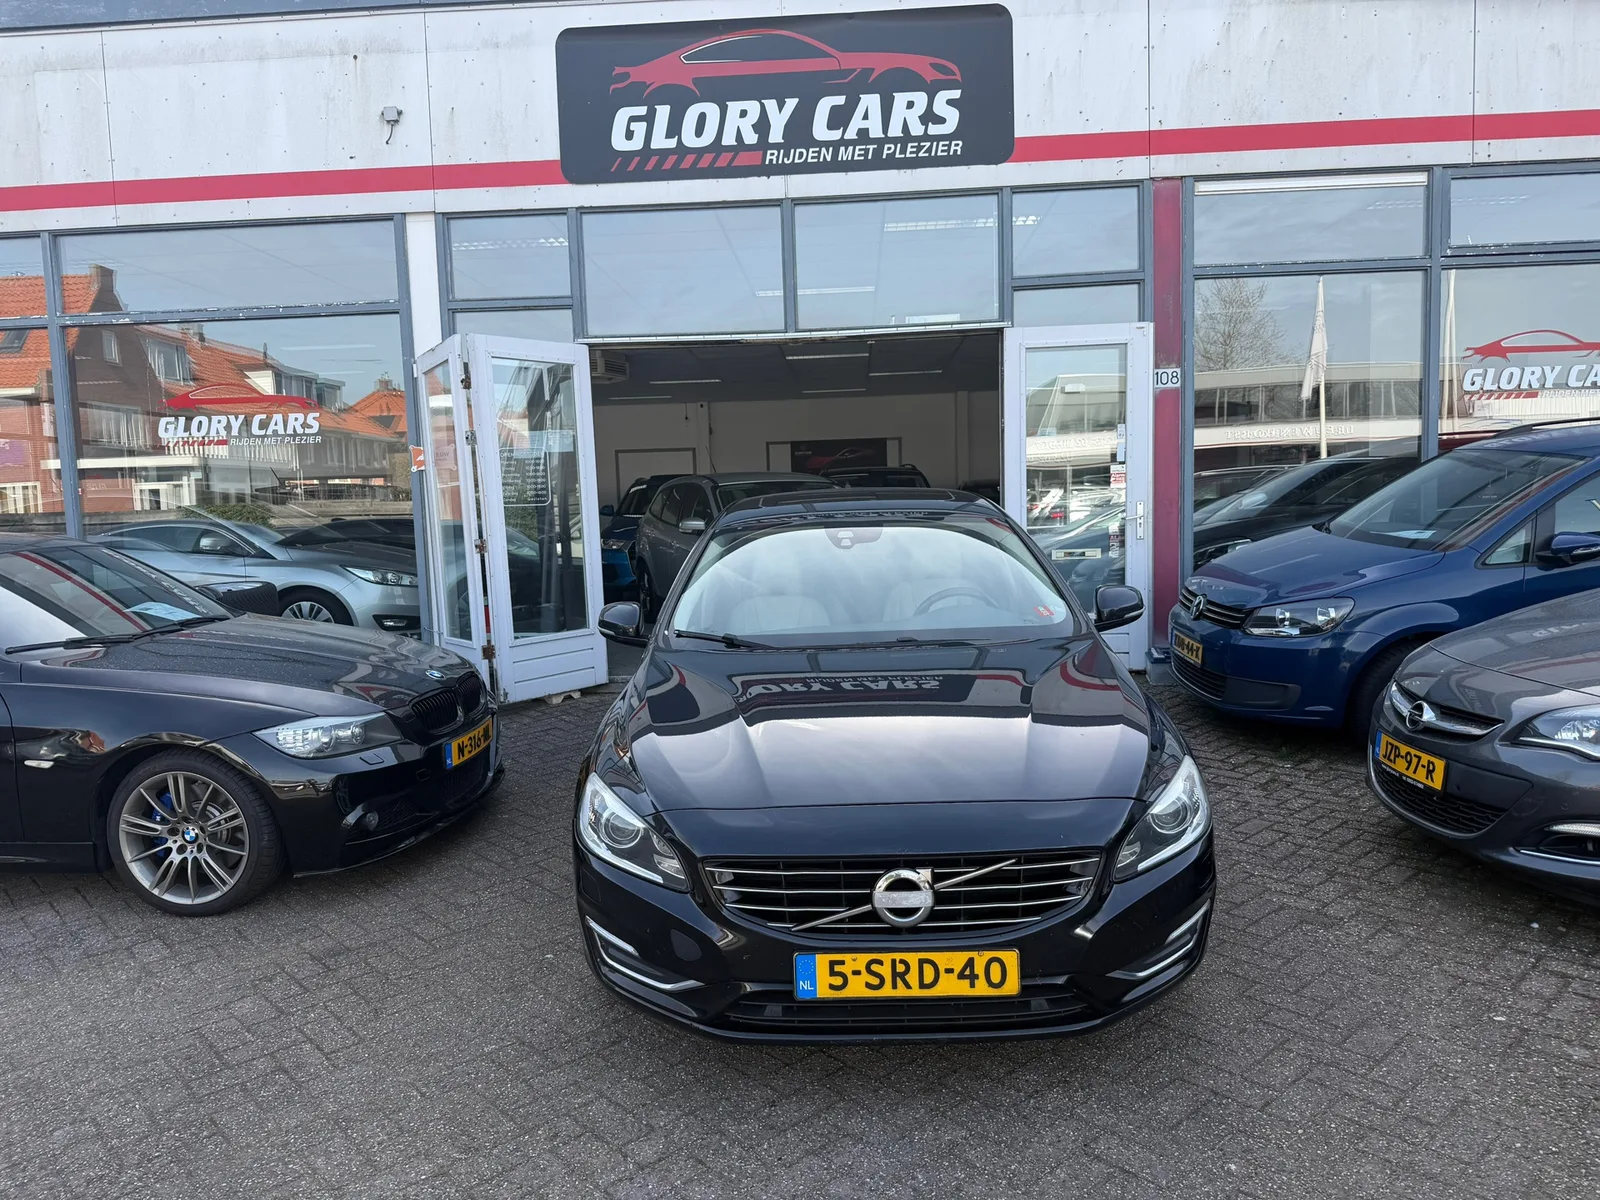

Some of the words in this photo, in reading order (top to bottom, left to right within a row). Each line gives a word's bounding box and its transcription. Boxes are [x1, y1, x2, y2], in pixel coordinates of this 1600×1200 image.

[610, 98, 799, 152] GLORY
[811, 89, 962, 142] CARS
[765, 147, 833, 165] RIJDEN
[837, 144, 878, 162] MET
[882, 140, 963, 159] PLEZIER
[1155, 371, 1179, 385] 108
[1462, 365, 1562, 391] GLORY
[158, 415, 245, 438] GLORY
[251, 412, 320, 436] CARS
[230, 438, 261, 446] RIJDEN
[263, 437, 282, 445] MET
[284, 436, 322, 444] PLEZIER
[1382, 740, 1436, 783] JZP-97-R
[799, 980, 814, 990] NL
[828, 956, 1008, 991] 5-SRD-40
